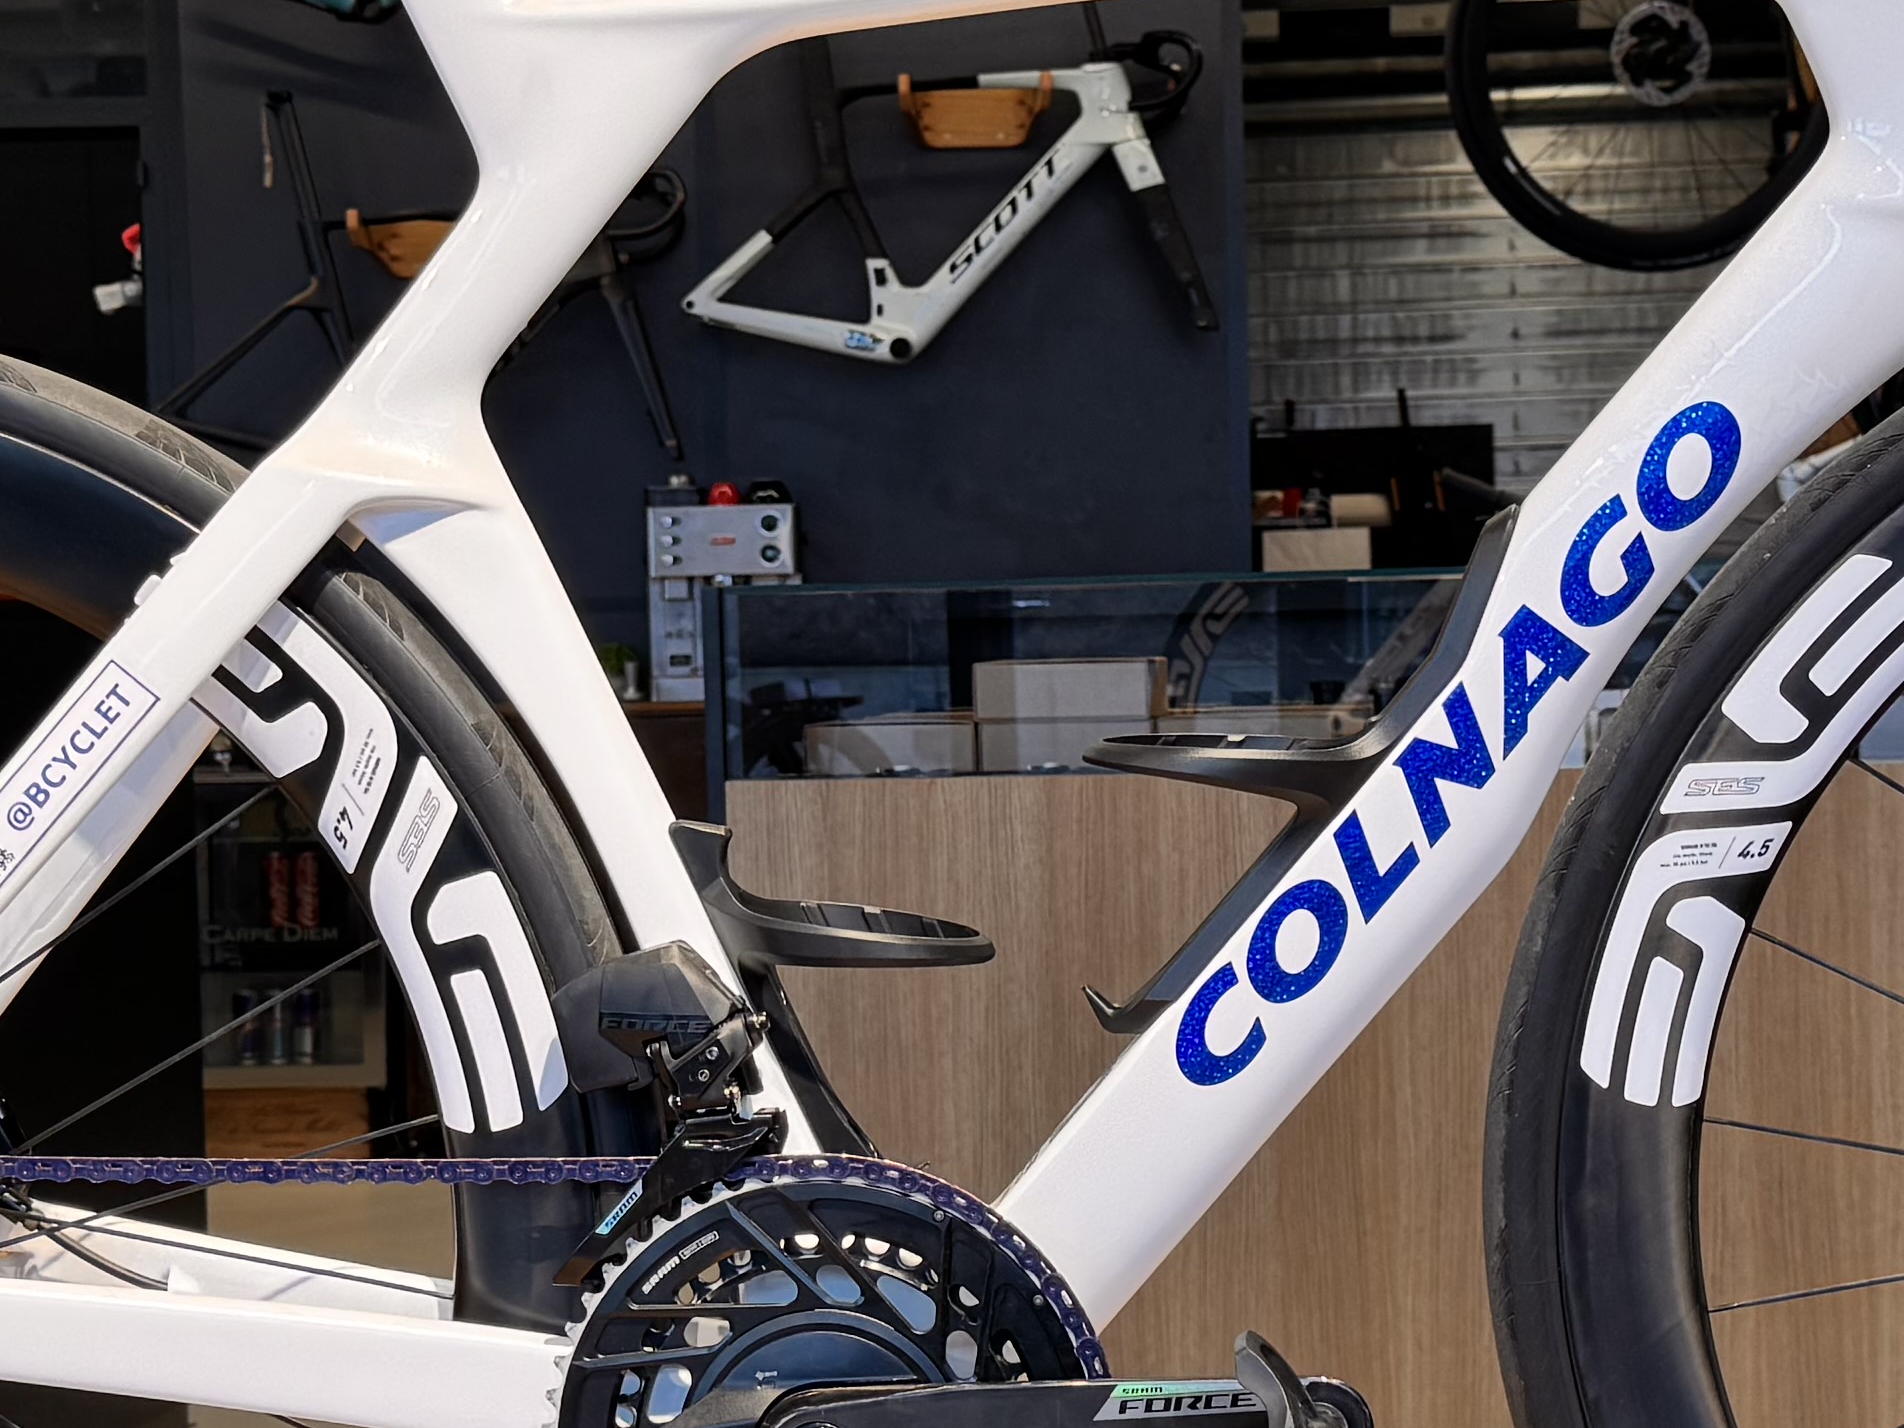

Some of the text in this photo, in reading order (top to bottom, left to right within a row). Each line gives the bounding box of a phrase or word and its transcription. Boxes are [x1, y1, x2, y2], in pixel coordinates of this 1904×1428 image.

[949, 147, 1062, 284] SCOTT
[6, 683, 132, 833] @BCYCLET
[1175, 399, 1744, 1088] COLNAGO
[1683, 776, 1765, 797] SES
[332, 806, 355, 851] 4.5
[397, 787, 442, 873] SES
[1737, 838, 1776, 859] 4.5
[282, 923, 339, 942] DIEM
[1118, 1393, 1257, 1415] FORCE
